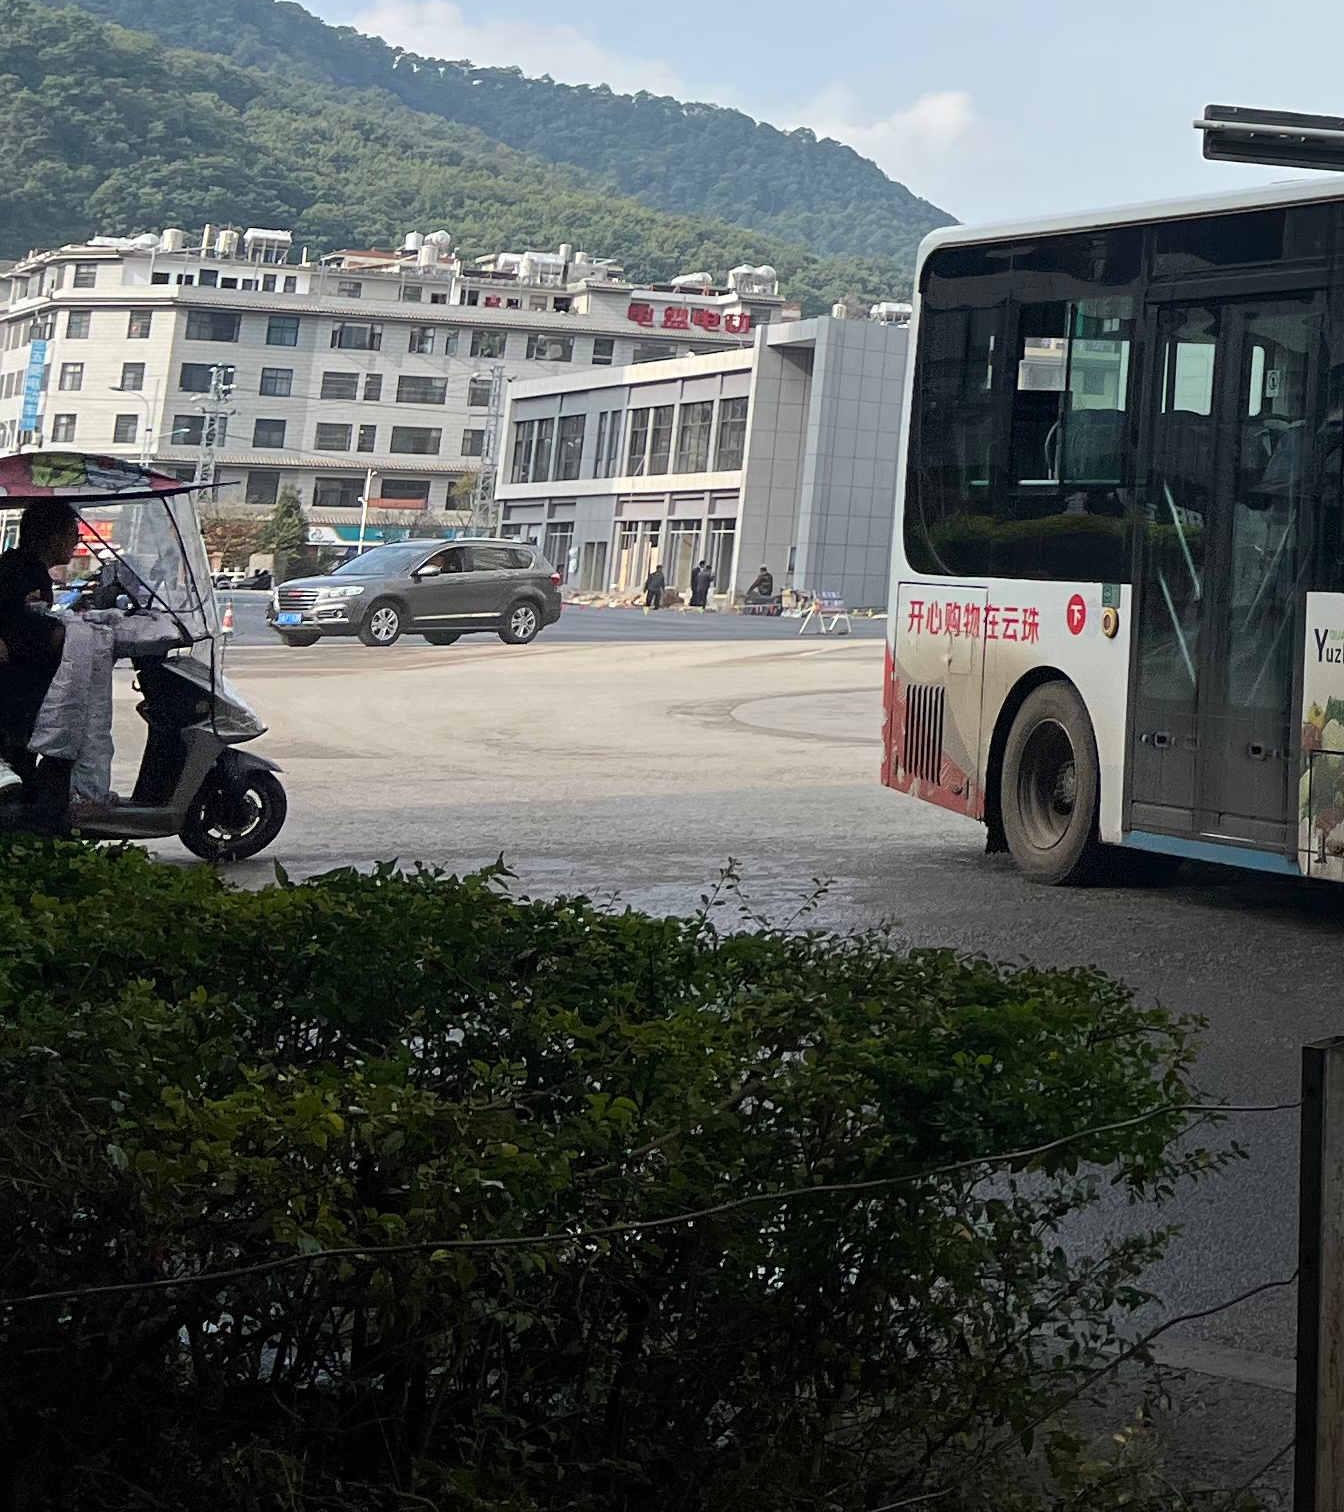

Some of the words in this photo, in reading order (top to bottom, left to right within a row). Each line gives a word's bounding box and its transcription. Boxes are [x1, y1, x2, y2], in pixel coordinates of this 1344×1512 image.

[907, 600, 1040, 645] 开心购物在云珠
[1070, 603, 1082, 627] 下
